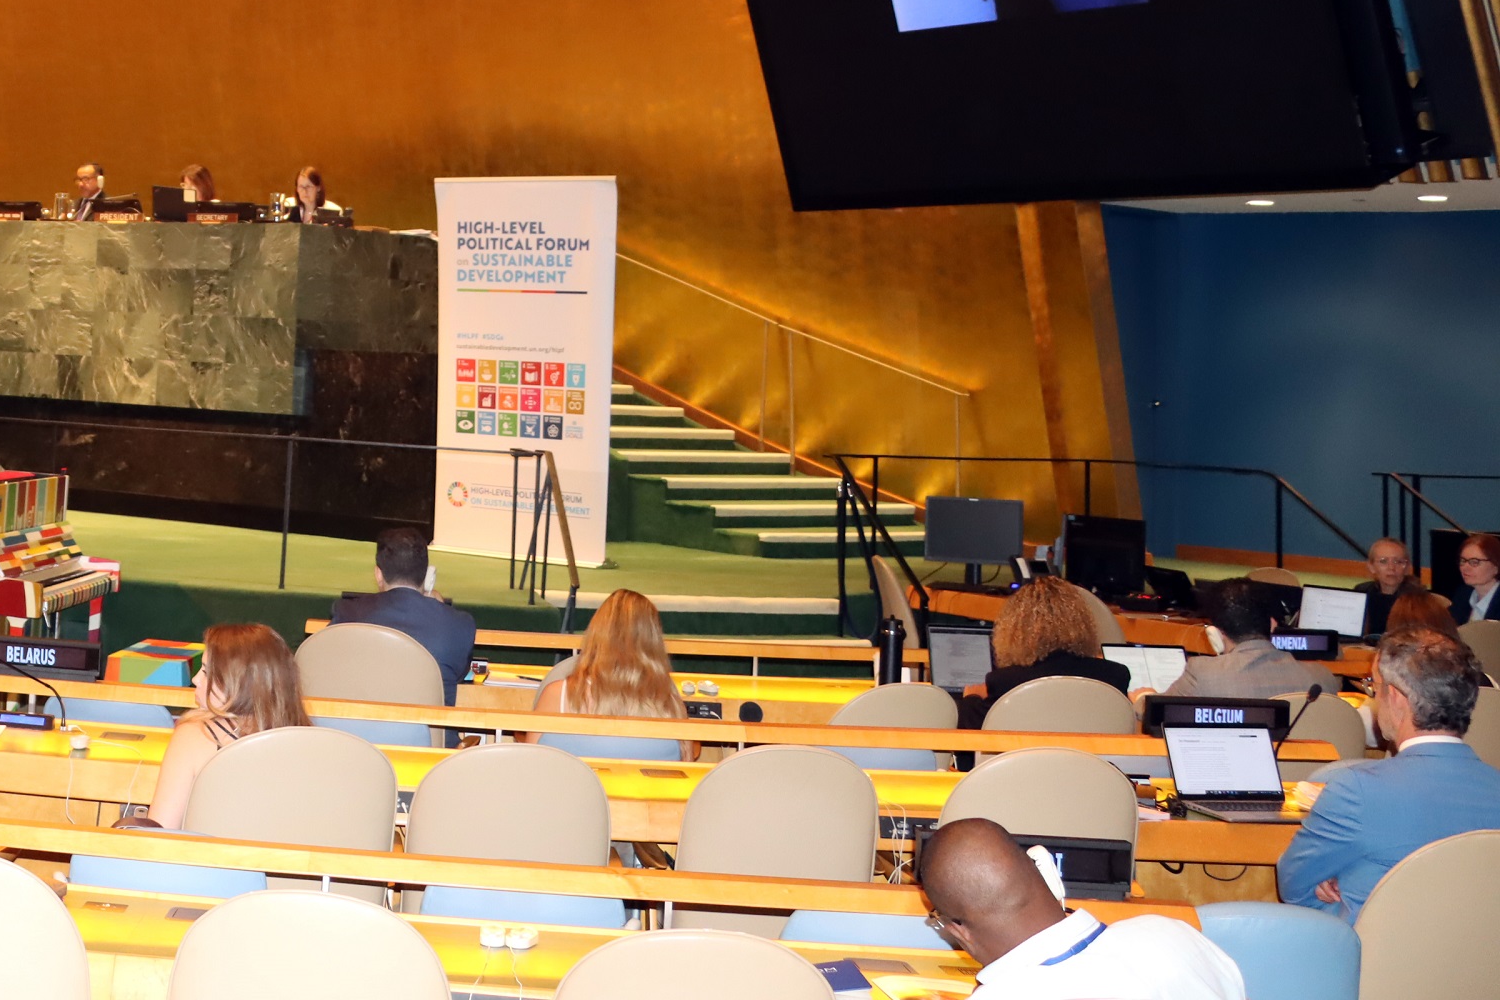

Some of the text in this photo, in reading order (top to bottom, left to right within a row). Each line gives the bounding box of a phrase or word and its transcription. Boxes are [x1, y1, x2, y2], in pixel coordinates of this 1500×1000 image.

[99, 213, 138, 221] PRESIDENT
[457, 221, 546, 235] HIGH-LEVEL
[457, 237, 591, 251] POLITICAL FORUM
[472, 253, 573, 267] SUSTAINABLE
[457, 269, 566, 284] DEVELOPMENT
[470, 487, 513, 498] HIGH-LEVEL
[1271, 636, 1307, 650] ARMENIA
[6, 645, 56, 665] BELARUS
[1194, 707, 1243, 723] BELGIUM
